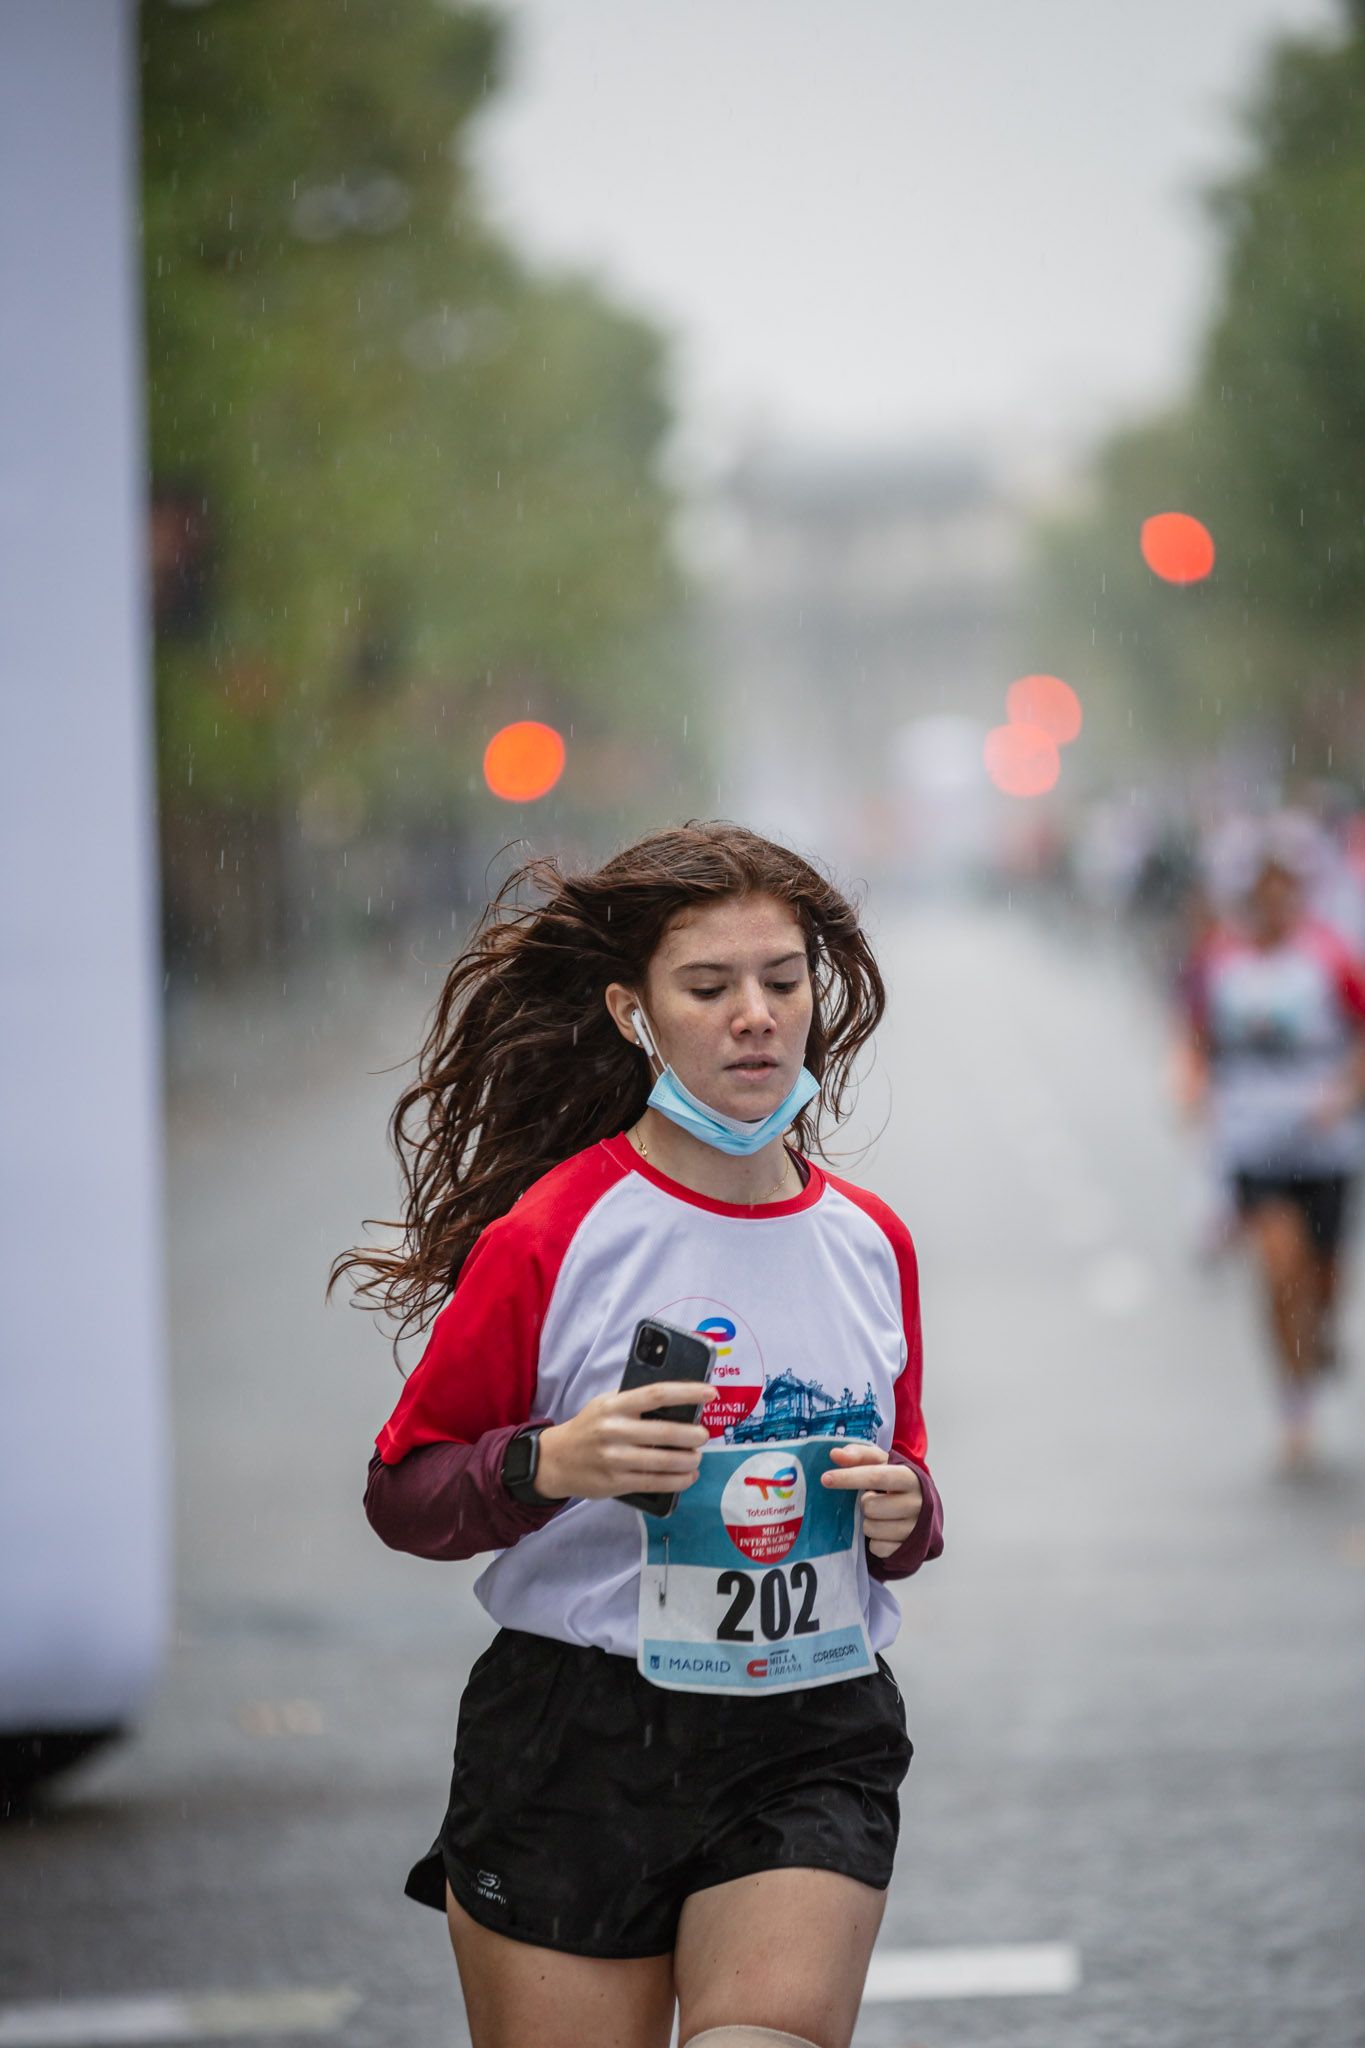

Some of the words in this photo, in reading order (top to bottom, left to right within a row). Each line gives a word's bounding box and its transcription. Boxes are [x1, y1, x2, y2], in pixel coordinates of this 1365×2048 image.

[746, 1504, 796, 1517] TotalEnergies
[762, 1525, 785, 1536] MILLA
[740, 1532, 797, 1547] INTERNACIONAL
[751, 1547, 765, 1557] DE
[766, 1543, 790, 1555] MADRID
[716, 1562, 820, 1642] 202
[669, 1658, 731, 1673] MADRID
[769, 1654, 797, 1665] MILLA
[769, 1664, 802, 1677] URBANA
